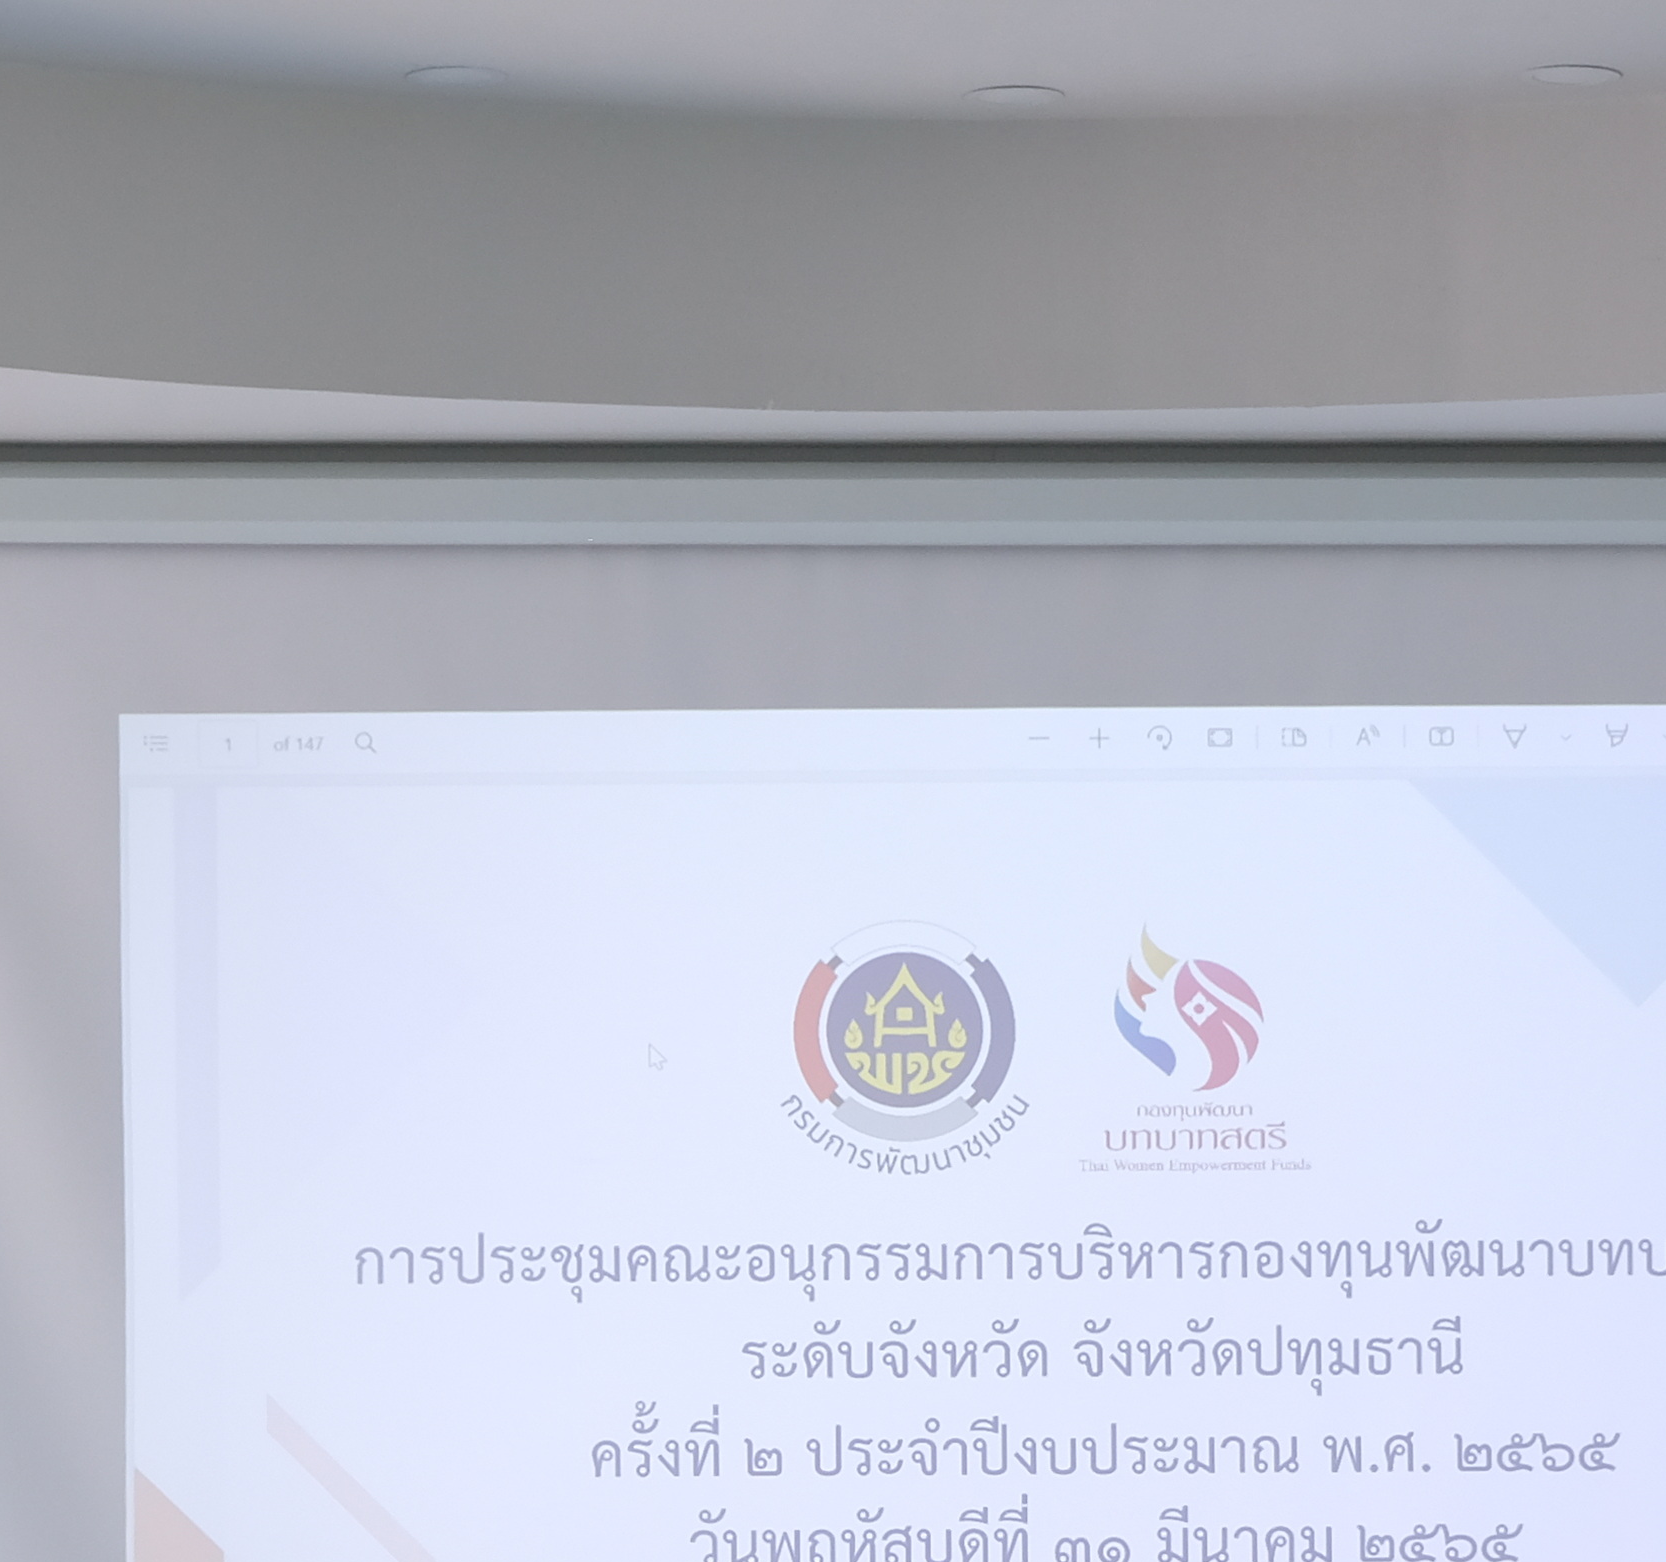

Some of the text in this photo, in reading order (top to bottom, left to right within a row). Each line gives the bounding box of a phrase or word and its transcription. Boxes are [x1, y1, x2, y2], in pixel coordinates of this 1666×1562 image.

[273, 736, 290, 752] of
[296, 736, 325, 752] 147
[1136, 1102, 1254, 1121] กองทุนพัฒนา
[781, 1093, 1030, 1176] กรมการพัฒนาชุมชน
[1104, 1120, 1288, 1151] บทบาทสตรี
[1079, 1158, 1313, 1175] Thai Women Empowerment Funds
[742, 1316, 1463, 1396] ระดับจังหวัด จังหวัดปทุมธานี
[592, 1401, 1620, 1477] ครั้งที่ ๒ ประจำปีงบประมาณ พ.ศ. ๒๕๖๕
[1357, 1523, 1523, 1562] ๒๕๖๕
